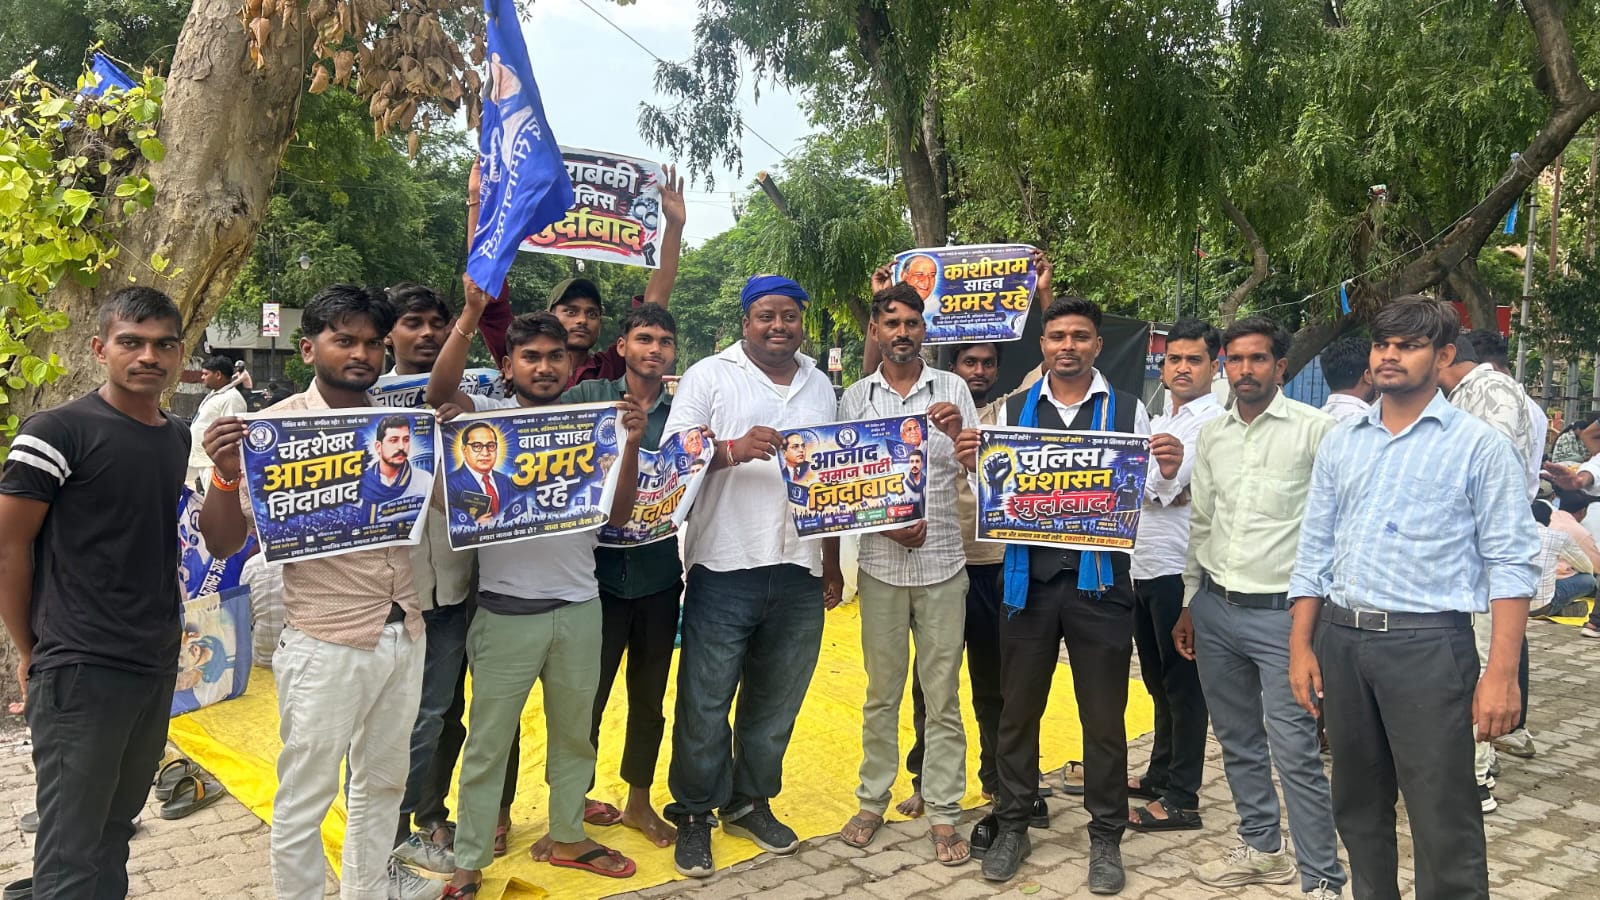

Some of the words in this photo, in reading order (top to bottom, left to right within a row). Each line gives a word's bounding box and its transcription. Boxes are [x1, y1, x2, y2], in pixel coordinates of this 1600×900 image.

[564, 158, 640, 195] राबंकी
[572, 184, 617, 212] लिस
[530, 207, 643, 251] ुर्दाबाद
[943, 257, 1030, 281] कांशीराम
[963, 277, 1005, 292] साहब
[940, 292, 996, 314] अमर
[999, 285, 1030, 312] रहे
[277, 430, 355, 460] चंद्रशेखर
[518, 433, 550, 449] बाबा
[554, 429, 593, 445] साहब
[263, 450, 365, 493] आज़ाद
[511, 442, 596, 486] अमर
[819, 466, 859, 483] समाज
[863, 457, 892, 476] पार्टी
[1019, 444, 1102, 475] पुलिस
[536, 476, 581, 508] रहे
[808, 473, 905, 511] ज़िंदाबाद
[1016, 468, 1113, 493] प्रशासन
[267, 480, 360, 522] ज़िंदाबाद
[1013, 490, 1112, 521] मुर्दाबाद
